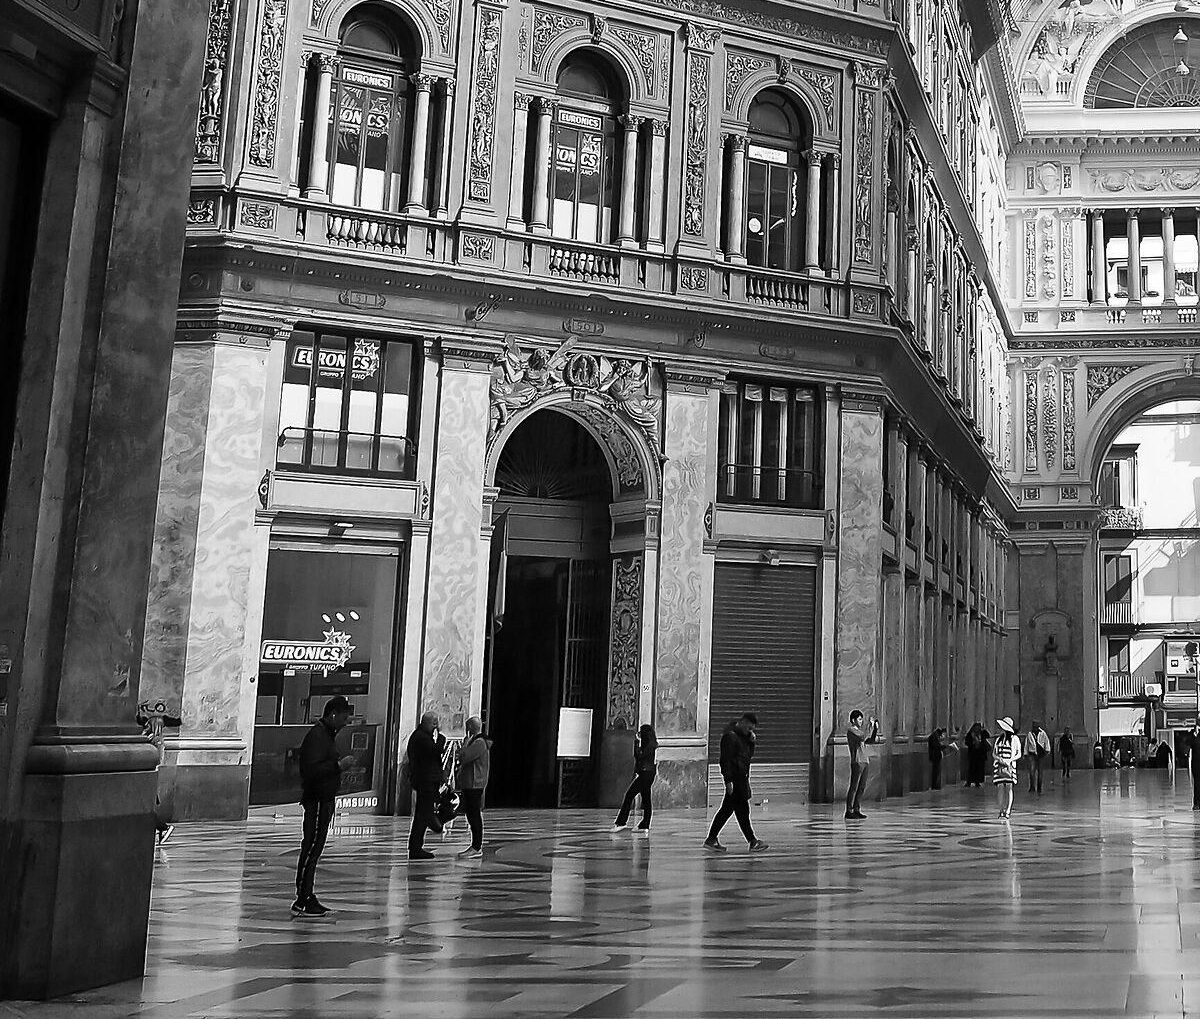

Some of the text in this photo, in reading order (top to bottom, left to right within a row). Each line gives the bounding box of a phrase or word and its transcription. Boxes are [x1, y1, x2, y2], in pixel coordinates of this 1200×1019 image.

[346, 71, 389, 88] EURONICS
[561, 113, 599, 128] EURONICS
[297, 349, 370, 370] EURONCS
[264, 645, 341, 661] EURONICS
[335, 796, 378, 809] AMSUNG
